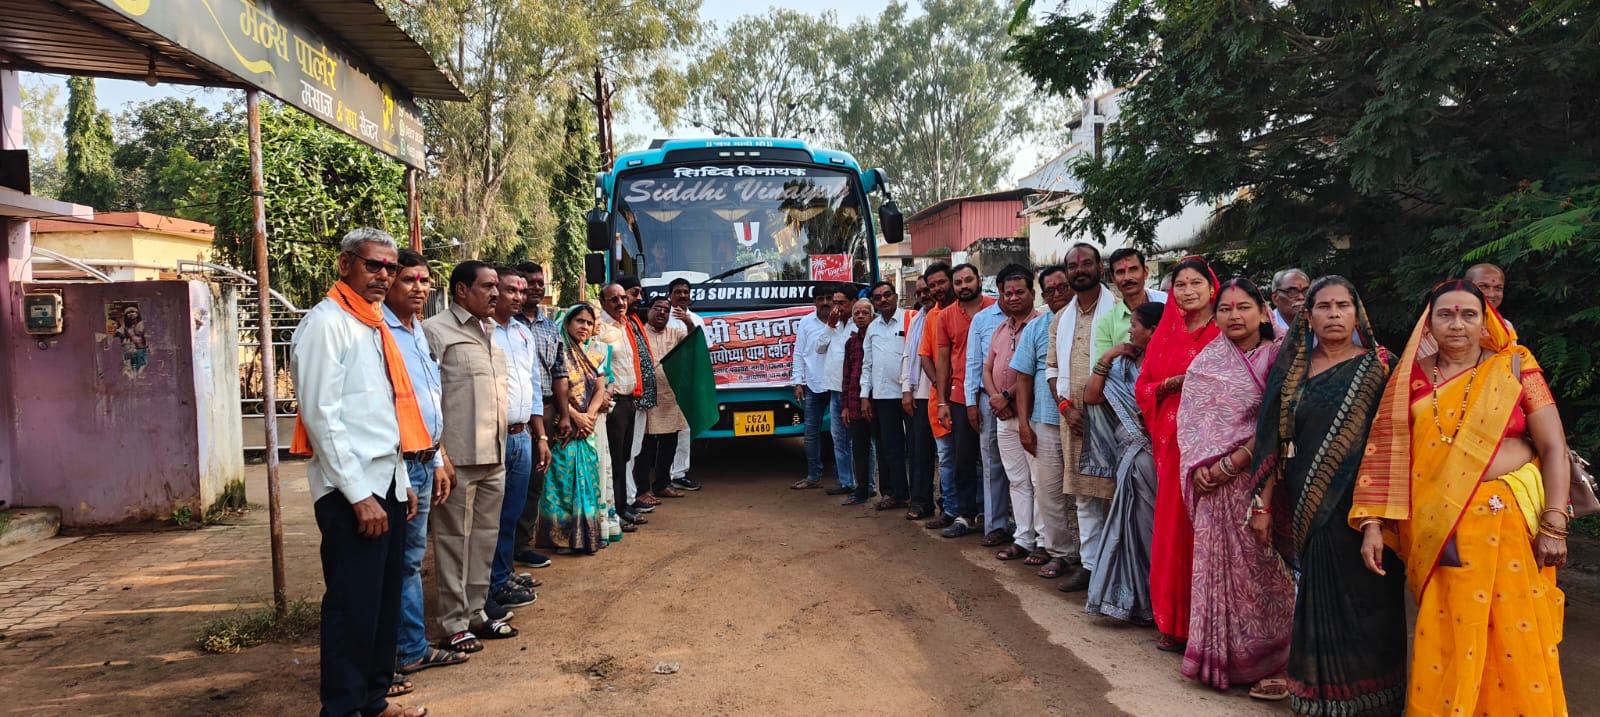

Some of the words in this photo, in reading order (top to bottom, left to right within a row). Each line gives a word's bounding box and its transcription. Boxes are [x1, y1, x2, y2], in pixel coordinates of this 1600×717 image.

[336, 100, 343, 122] &
[737, 165, 807, 176] विनायक
[624, 179, 727, 202] Siddhi
[708, 287, 752, 300] SUPER
[754, 286, 806, 299] LUXURY
[710, 346, 744, 364] योध्या
[767, 339, 791, 359] दर्शन
[747, 414, 767, 424] CG24
[744, 424, 771, 433] W4480
